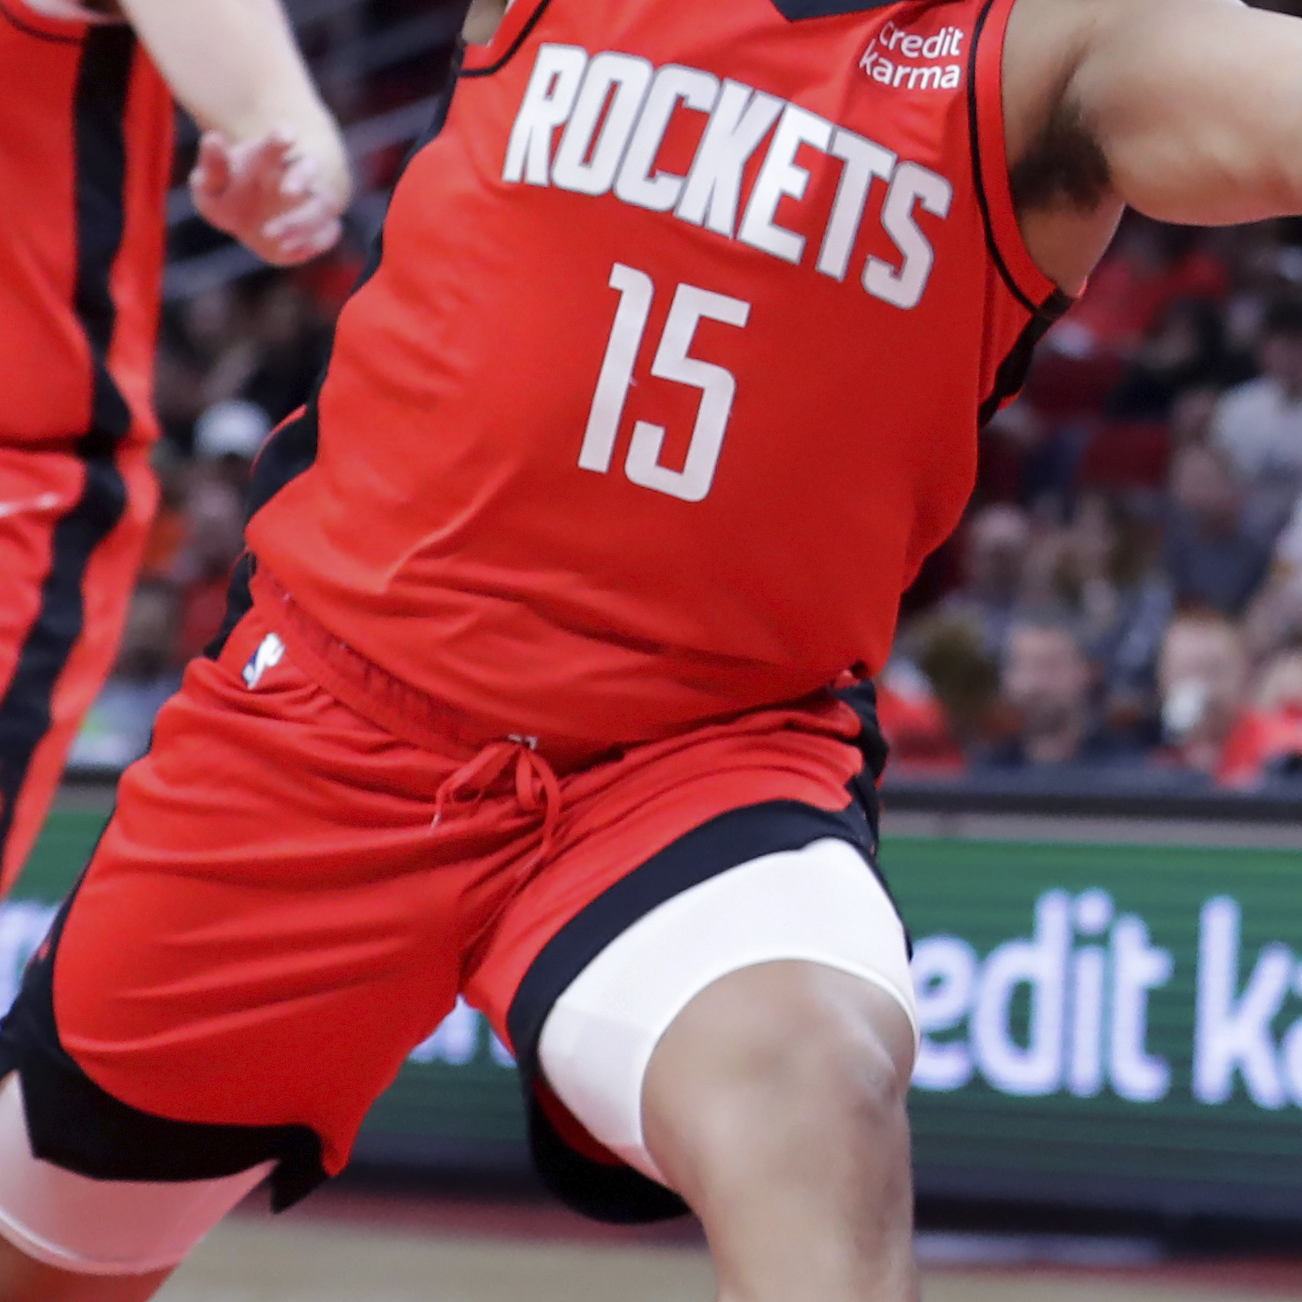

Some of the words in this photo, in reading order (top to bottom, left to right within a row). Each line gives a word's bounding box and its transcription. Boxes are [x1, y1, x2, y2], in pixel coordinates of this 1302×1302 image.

[859, 38, 962, 90] karma
[879, 20, 965, 59] credit
[502, 41, 953, 311] ROCKETS
[577, 261, 752, 503] 15
[908, 888, 1173, 1101] edit
